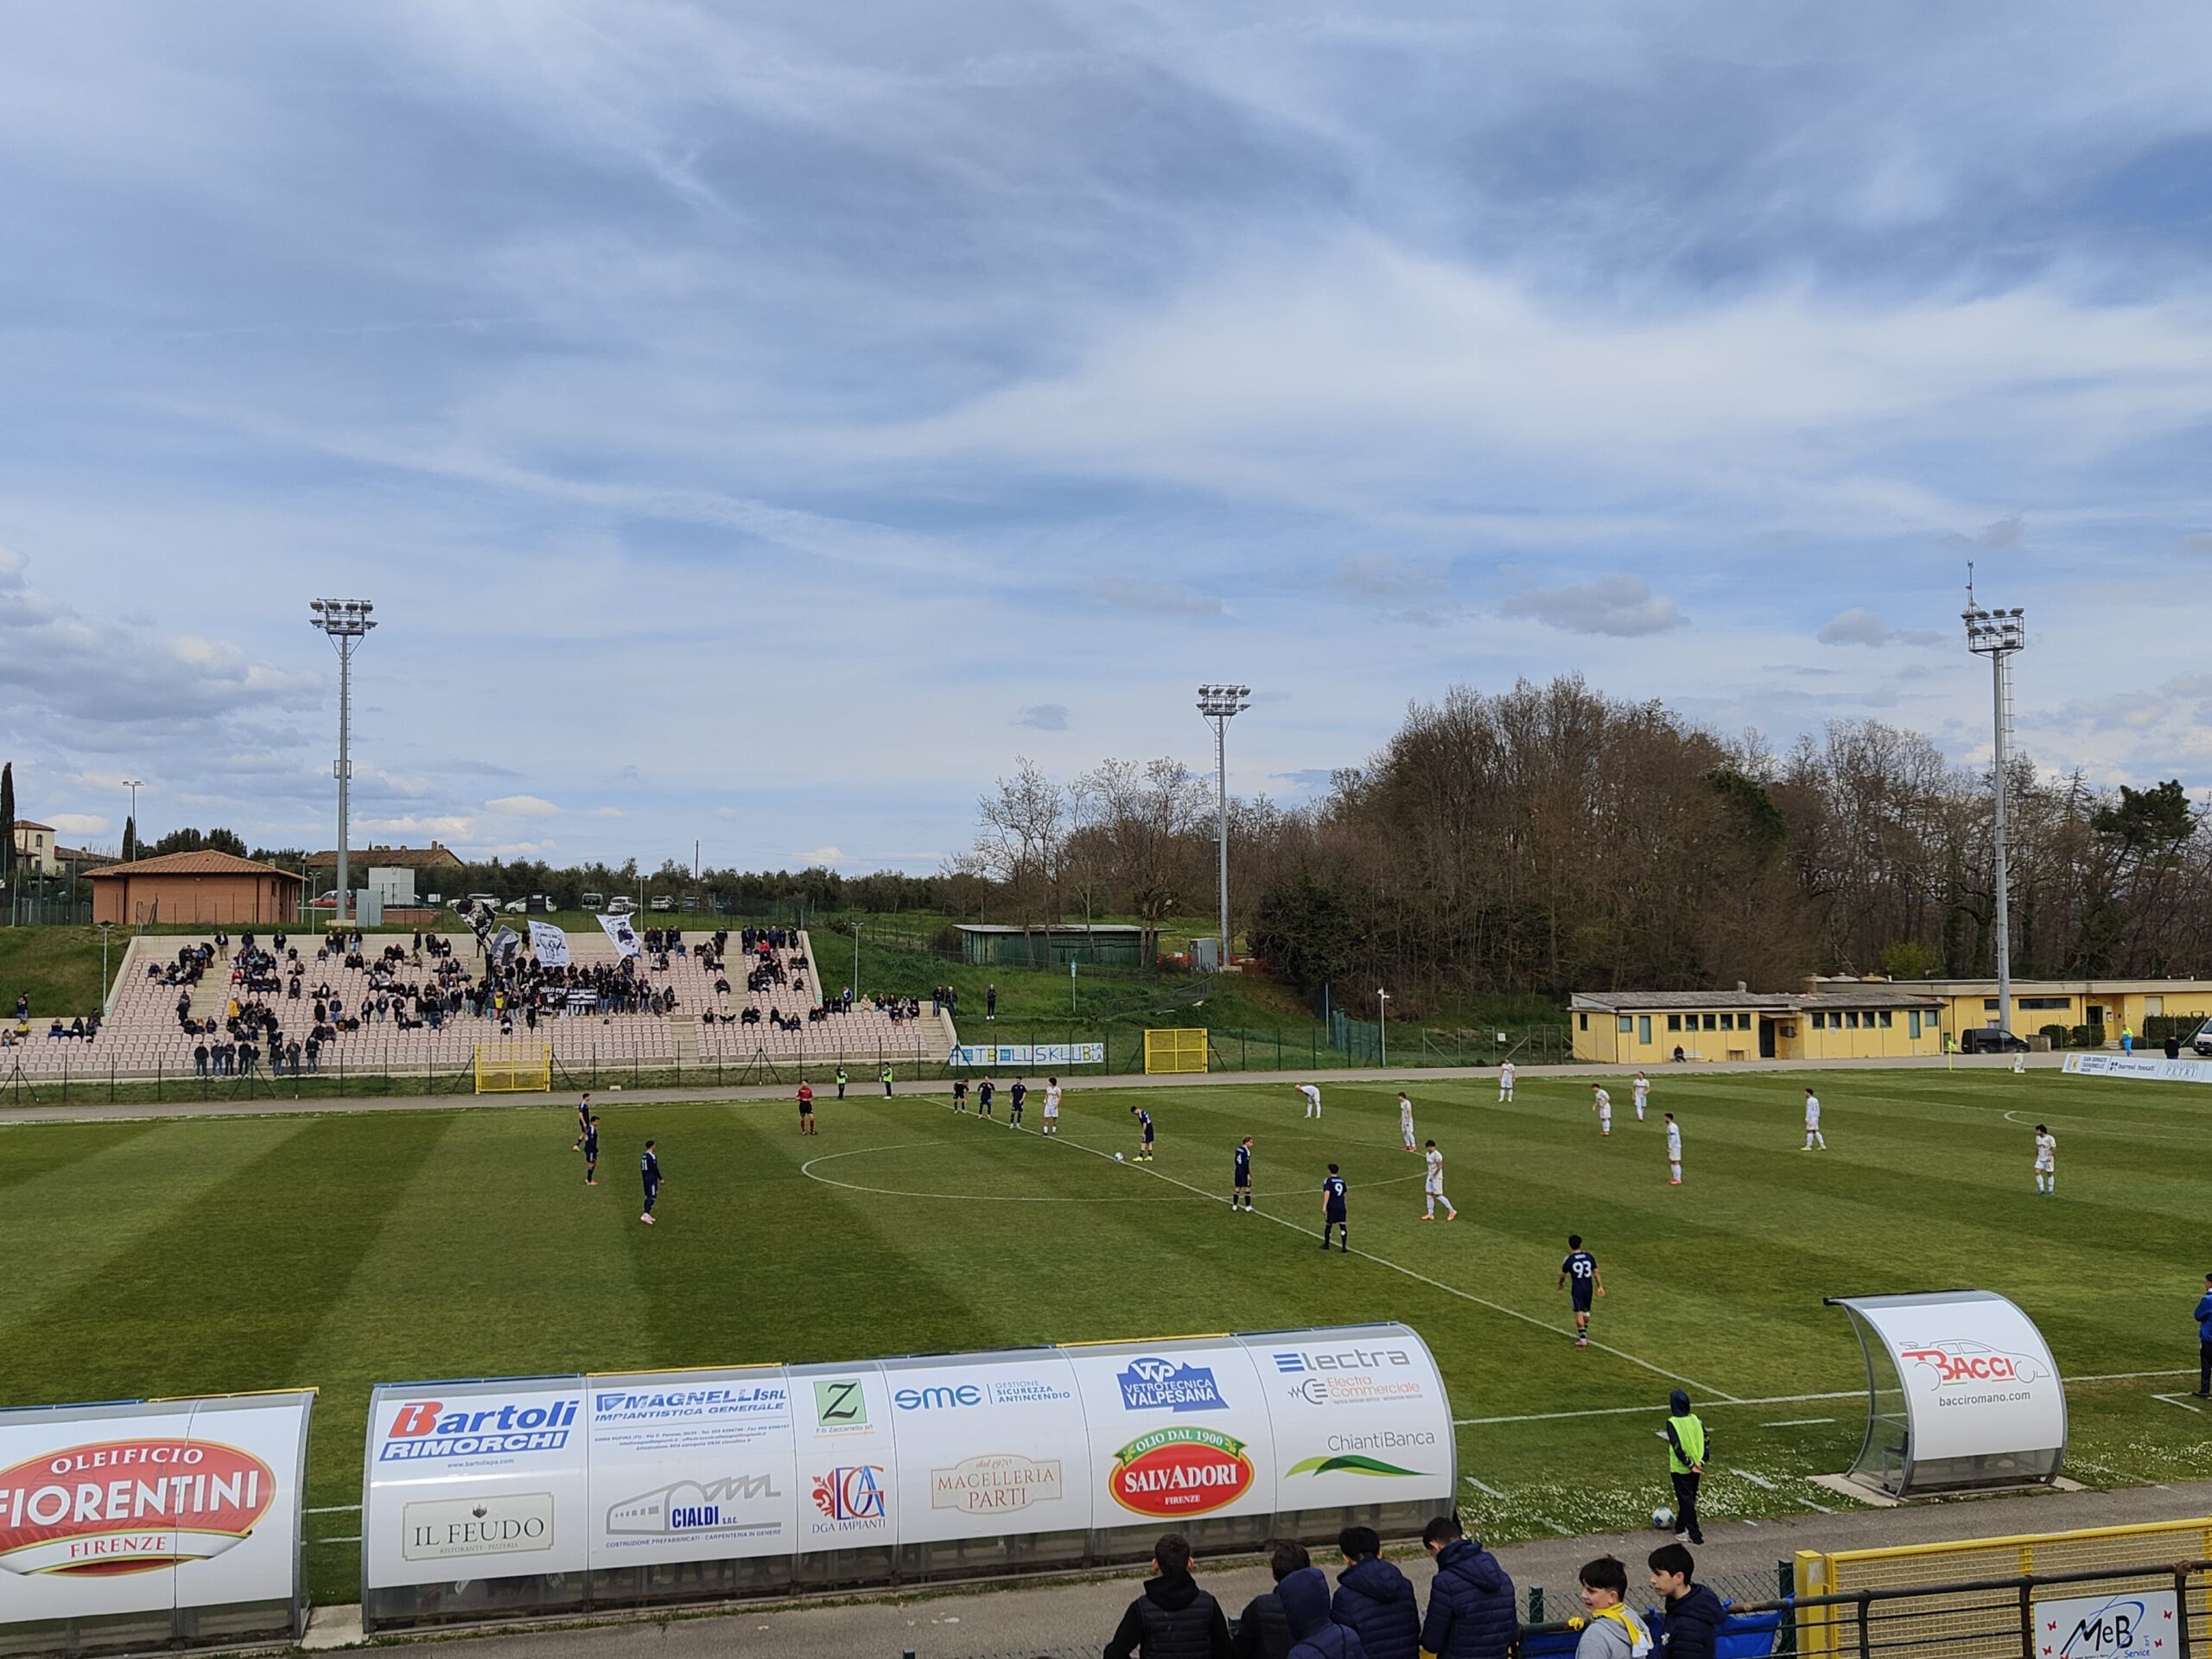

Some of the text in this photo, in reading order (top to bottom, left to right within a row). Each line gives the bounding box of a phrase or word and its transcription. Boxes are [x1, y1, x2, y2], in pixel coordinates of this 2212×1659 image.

[1236, 1153, 1243, 1165] 4
[1334, 1183, 1344, 1197] 9
[1573, 1261, 1592, 1279] 93
[1901, 1350, 2015, 1381] BACCI
[995, 1379, 1039, 1389] GESTIONE
[996, 1386, 1053, 1395] SICUREZZA
[1124, 1378, 1213, 1394] VETROTECNICA
[1327, 1376, 1372, 1387] Electra
[822, 1382, 858, 1421] Z
[999, 1391, 1071, 1403] ANTINCENDIO
[1127, 1387, 1217, 1406] VALPESANA
[1939, 1391, 2031, 1408] bacciromano.com
[388, 1400, 580, 1439] Bartoli
[594, 1402, 785, 1422] IMPIANTISTICA GENERALE
[385, 1432, 567, 1459] RIMORCHI
[1135, 1429, 1224, 1452] OLIO DAL 1900
[1327, 1430, 1435, 1452] ChiantiBanca
[51, 1448, 203, 1474] OLEIFICIO
[938, 1468, 1054, 1491] MACELLERIA
[1124, 1464, 1238, 1493] SALVADORI
[969, 1488, 1027, 1509] PARTI
[1165, 1494, 1201, 1505] FIRENZE
[672, 1506, 719, 1528] CIALDI
[812, 1518, 886, 1534] DGA IMPIANTI
[414, 1517, 544, 1547] IL FEUDO
[606, 1540, 650, 1548] COSTRUZIONE
[652, 1535, 700, 1545] PREFABBRICATI
[705, 1532, 747, 1541] CARPENTERIA
[70, 1535, 166, 1558] FIRENZE
[440, 1545, 483, 1554] RISTORANTE
[2124, 1649, 2151, 1659] Service
